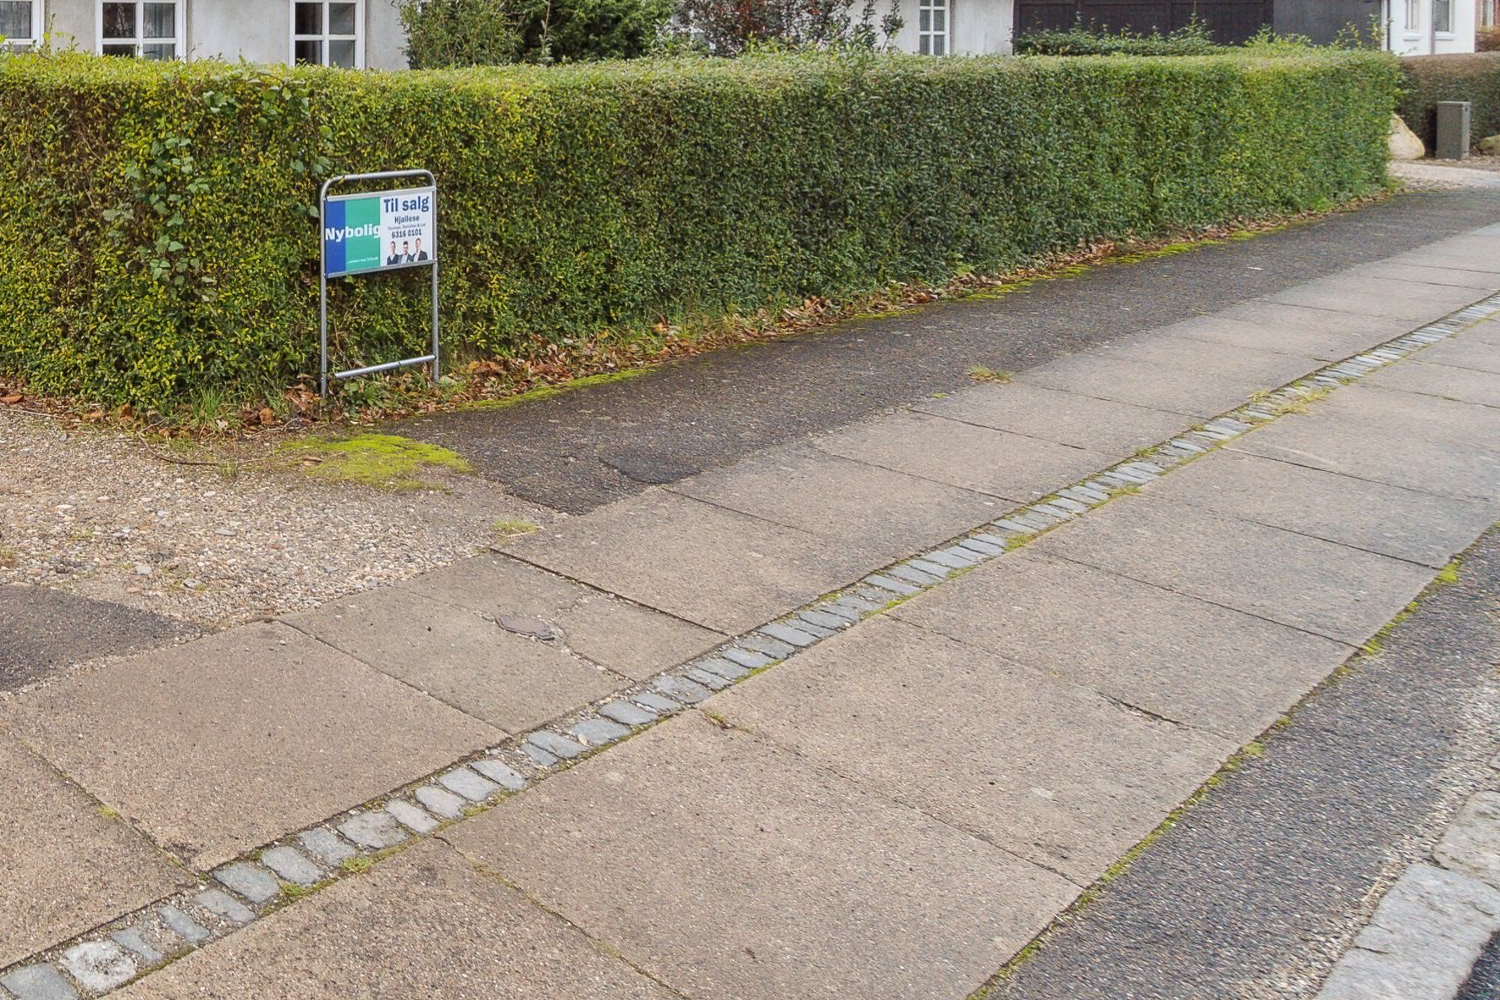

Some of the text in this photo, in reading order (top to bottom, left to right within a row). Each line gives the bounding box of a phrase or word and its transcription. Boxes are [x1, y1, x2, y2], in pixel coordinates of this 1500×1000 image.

[383, 195, 429, 213] Til salg
[394, 215, 420, 224] Hjallese
[325, 223, 380, 242] Nybolig
[391, 228, 422, 239] 6316 0101
